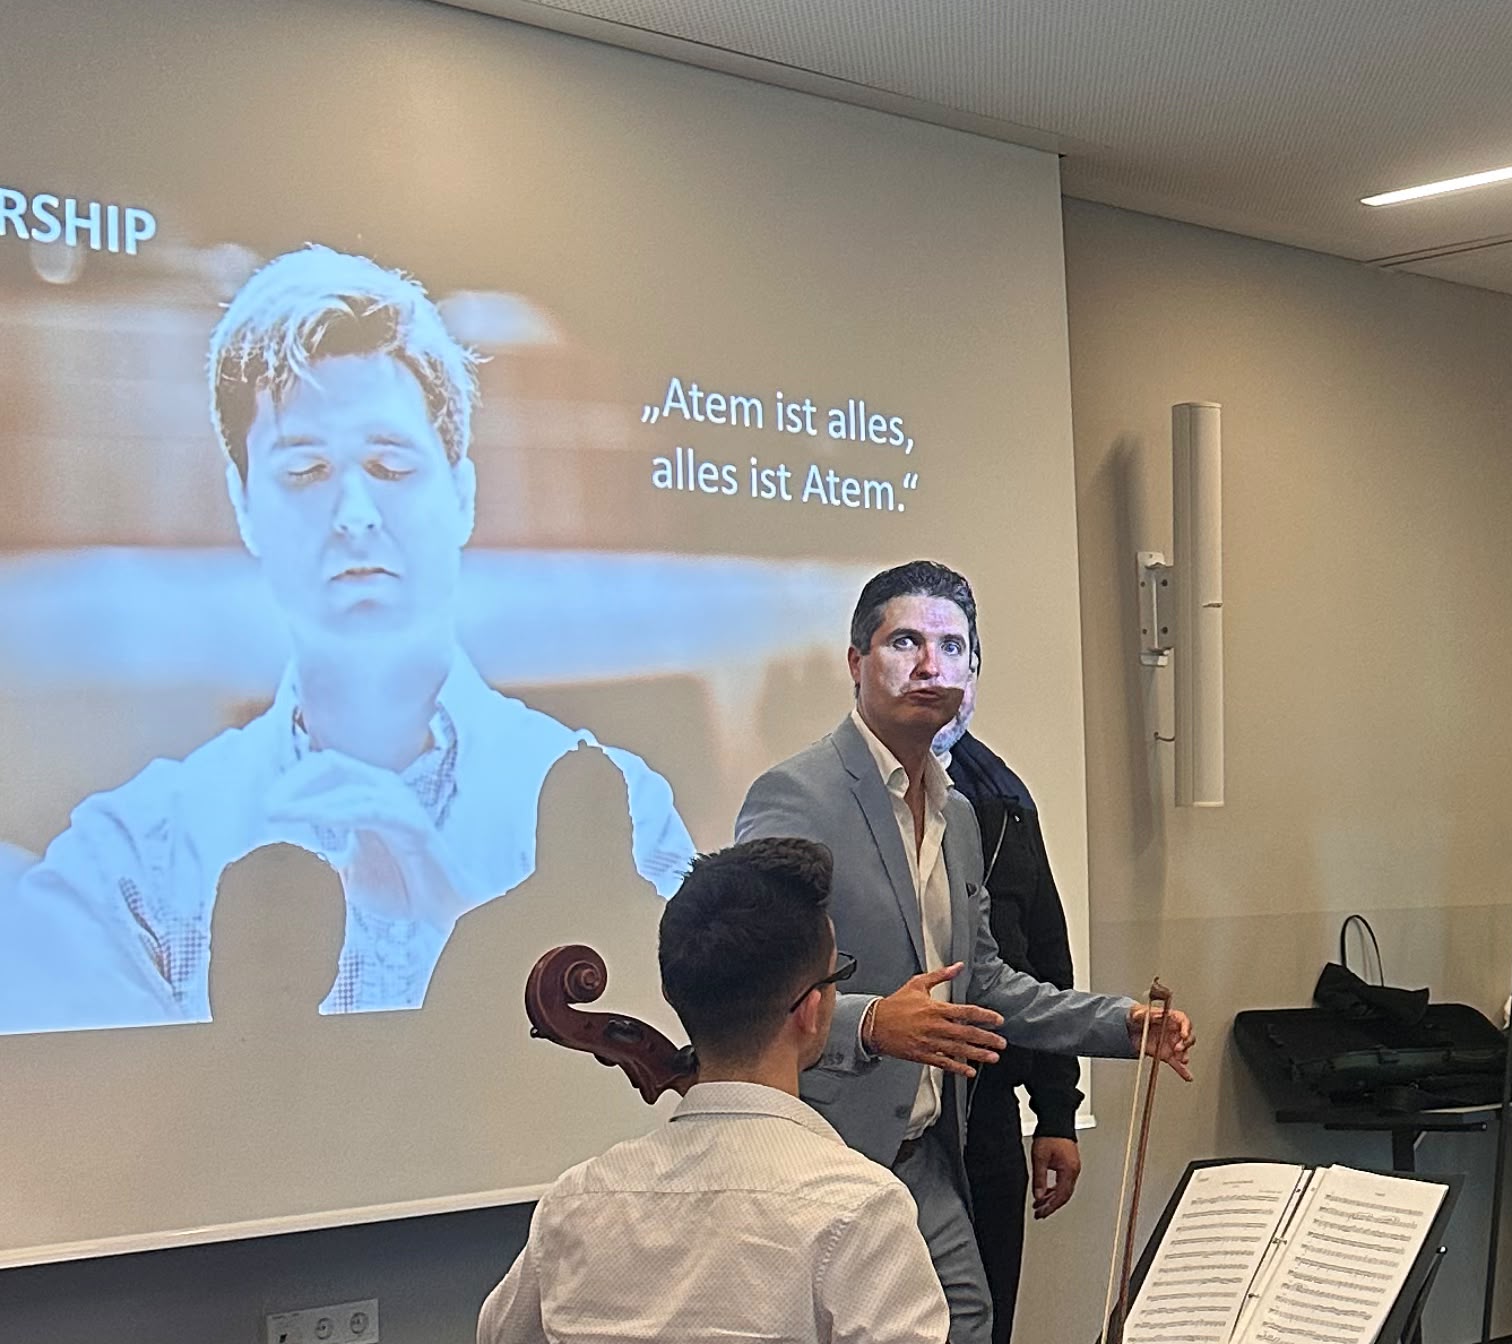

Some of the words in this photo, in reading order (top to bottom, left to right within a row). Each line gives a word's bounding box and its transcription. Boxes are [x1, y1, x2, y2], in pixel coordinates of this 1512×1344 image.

[0, 187, 157, 255] RSHIP
[640, 377, 763, 429] „Atem
[775, 391, 817, 436] ist
[827, 399, 914, 455] alles,
[651, 447, 738, 495] alles
[750, 456, 793, 501] ist
[801, 464, 919, 513] Atem.“
